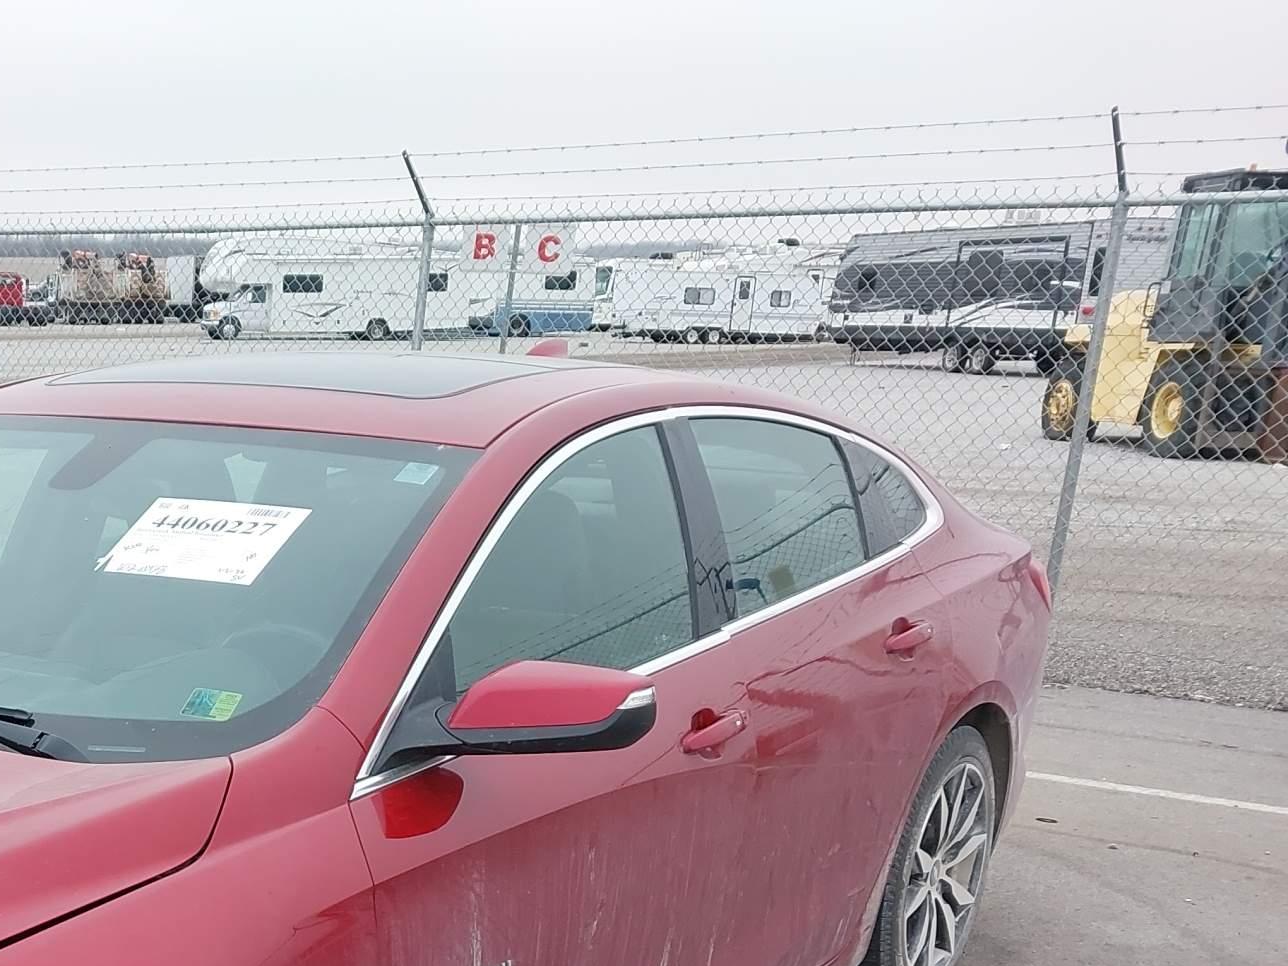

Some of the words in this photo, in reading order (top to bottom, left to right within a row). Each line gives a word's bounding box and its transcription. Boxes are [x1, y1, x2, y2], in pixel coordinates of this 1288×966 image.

[473, 233, 496, 259] B
[538, 234, 562, 262] C
[152, 514, 279, 536] 44060227
